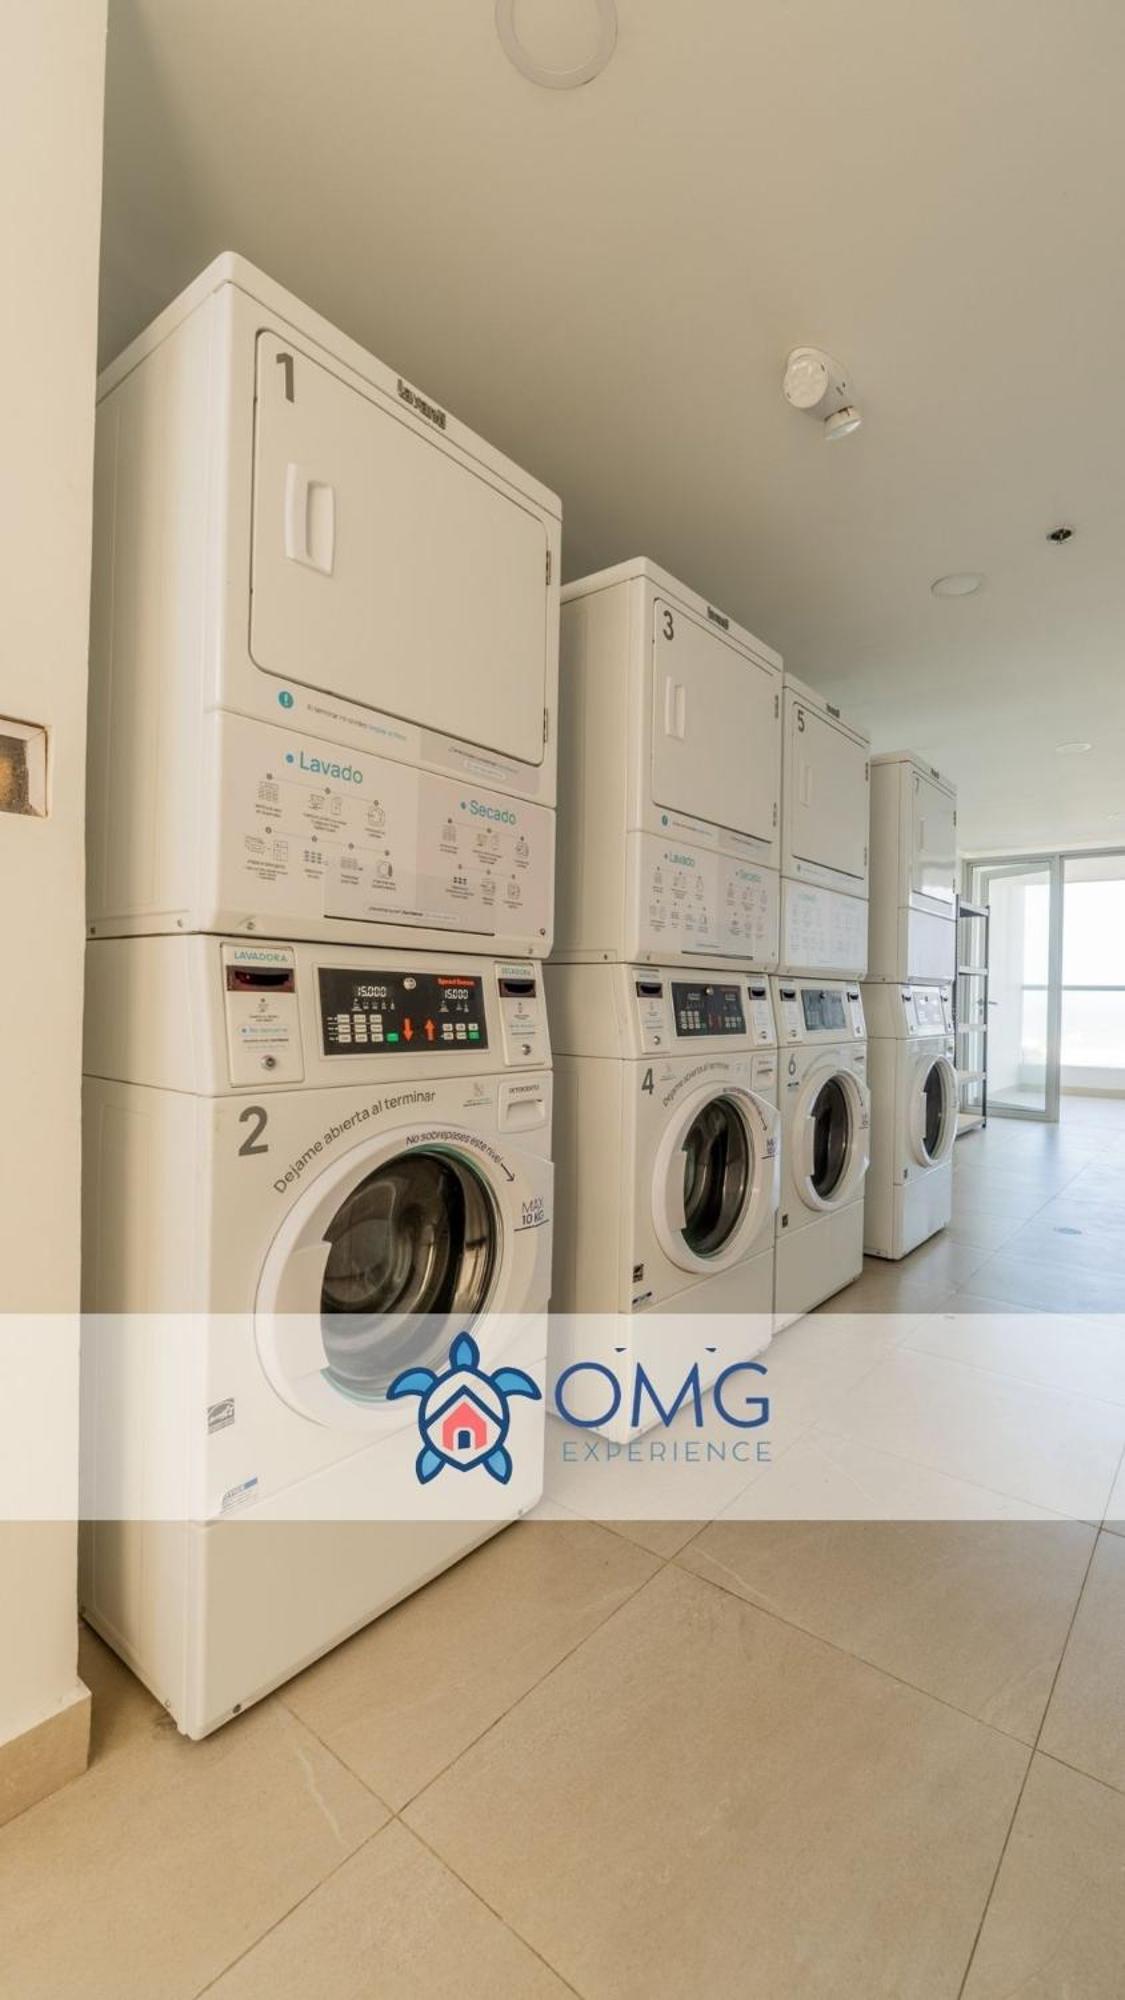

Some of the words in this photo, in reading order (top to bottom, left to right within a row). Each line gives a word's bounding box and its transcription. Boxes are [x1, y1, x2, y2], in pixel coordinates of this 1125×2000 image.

[276, 352, 295, 404] 1
[663, 610, 674, 640] 3
[797, 709, 805, 732] 5
[300, 751, 364, 785] Lavado
[469, 800, 517, 826] Secado
[234, 950, 288, 963] LAVADORA
[788, 1053, 796, 1076] 6
[642, 1067, 655, 1095] 4
[238, 1105, 269, 1157] 2
[273, 1141, 324, 1194] Dejame
[324, 1108, 371, 1145] abierta
[371, 1100, 383, 1116] al
[384, 1090, 437, 1110] terminar
[406, 1135, 420, 1146] No
[420, 1131, 471, 1144] sobrepases
[470, 1137, 488, 1152] este
[522, 1197, 544, 1213] MAX
[522, 1214, 533, 1226] 10
